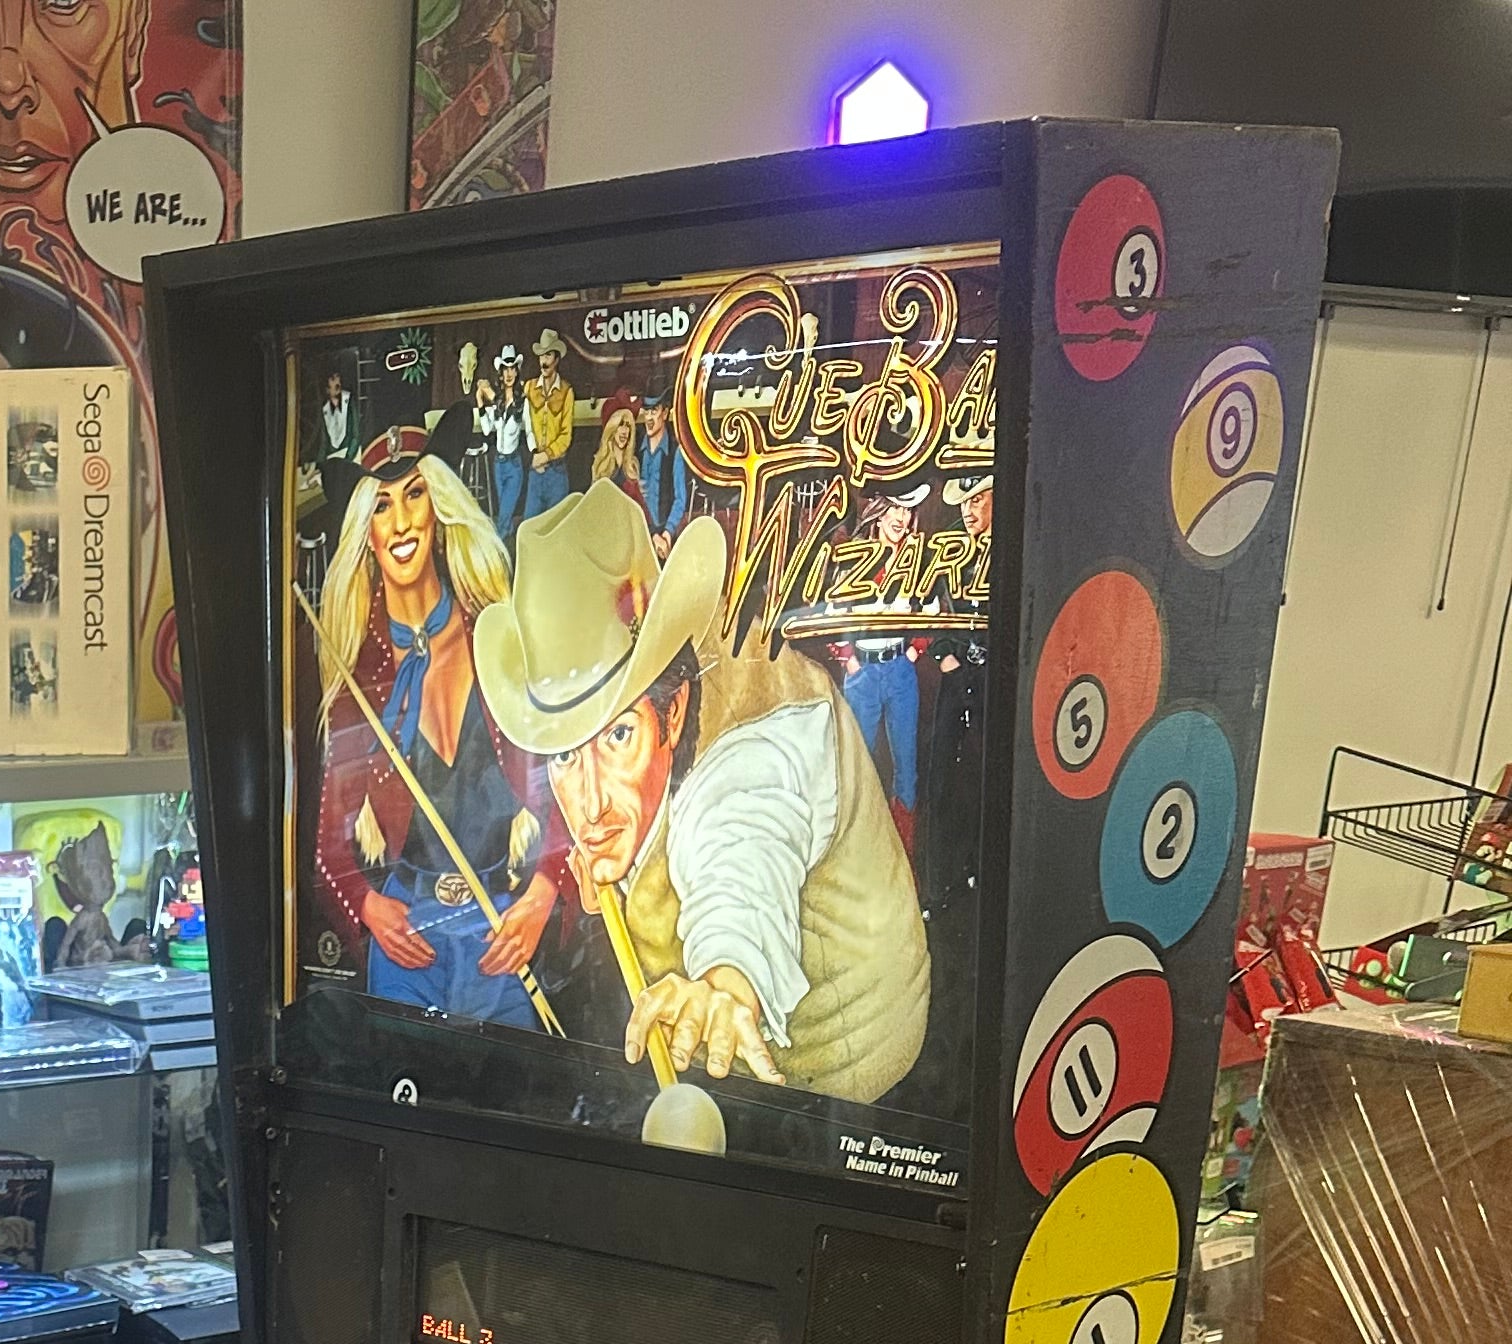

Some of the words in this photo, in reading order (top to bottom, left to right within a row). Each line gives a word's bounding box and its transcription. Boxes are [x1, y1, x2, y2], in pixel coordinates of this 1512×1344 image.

[86, 189, 123, 223] WE
[134, 192, 207, 226] ARE...
[1129, 249, 1147, 297] 3
[584, 303, 691, 343] Gottlieb
[76, 383, 111, 454] Sega
[1220, 411, 1241, 453] 9
[83, 494, 110, 653] Dreamcast
[1072, 700, 1094, 748] 5
[1159, 806, 1184, 859] 2
[1064, 1044, 1103, 1118] 11
[840, 1136, 866, 1153] The
[868, 1136, 942, 1166] Premier
[845, 1155, 888, 1175] Name
[905, 1164, 960, 1187] Pinball
